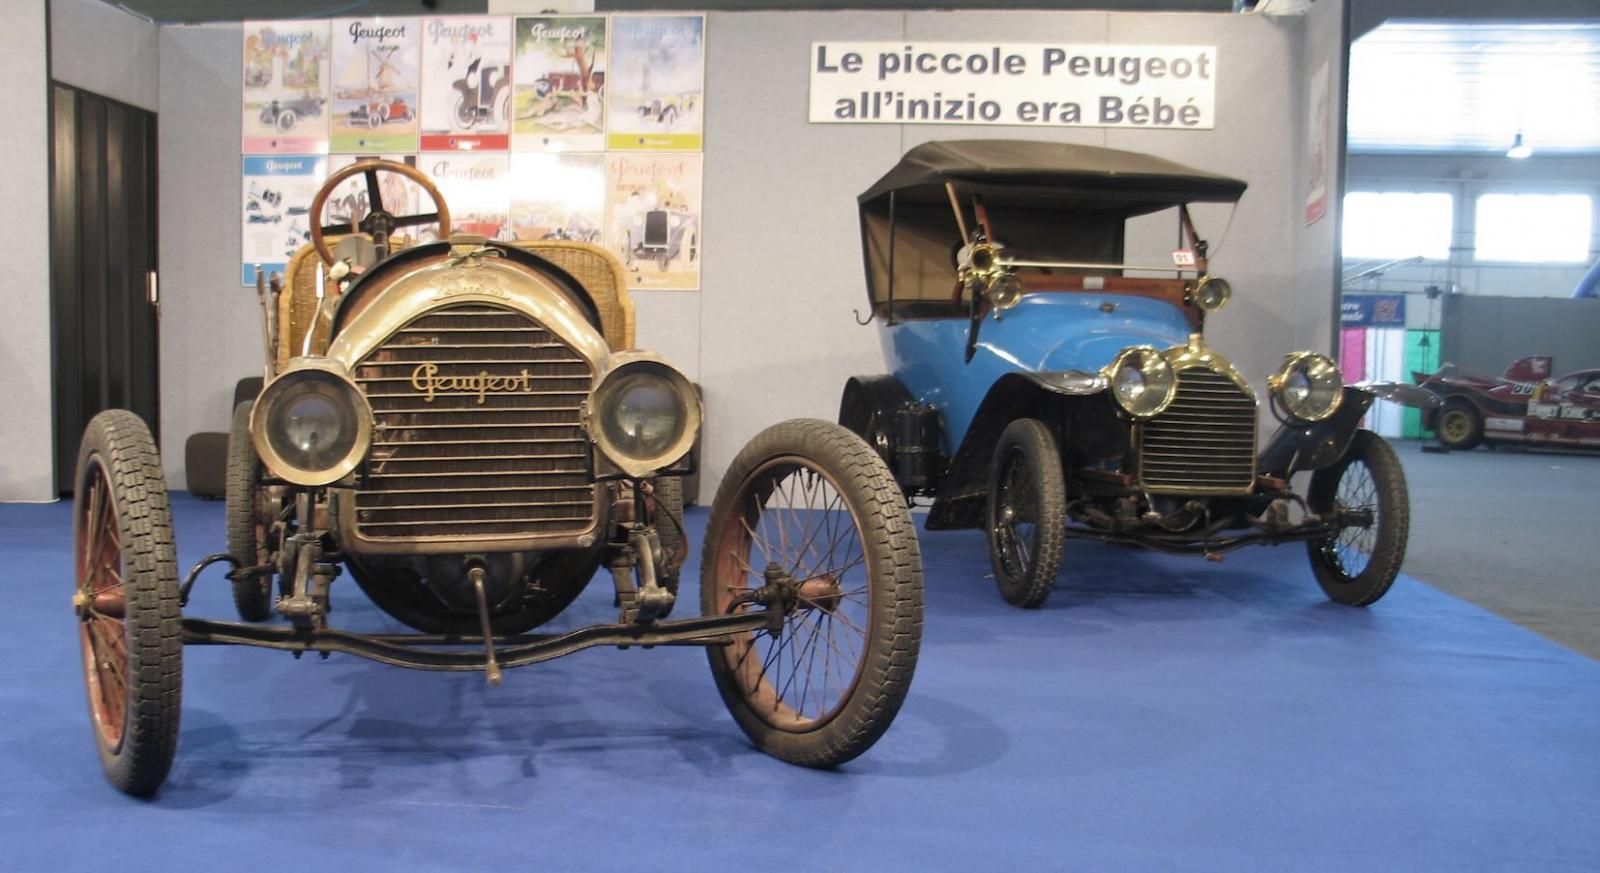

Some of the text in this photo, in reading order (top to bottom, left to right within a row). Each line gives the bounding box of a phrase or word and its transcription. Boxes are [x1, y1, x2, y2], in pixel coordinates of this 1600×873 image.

[349, 21, 405, 44] Peugeot
[427, 19, 494, 44] Peugeot
[531, 23, 586, 44] Peugeot
[816, 45, 1211, 84] Le piccole Peugeot
[1016, 99, 1082, 124] era
[1098, 95, 1202, 127] Bébé
[411, 363, 532, 404] Peugeot
